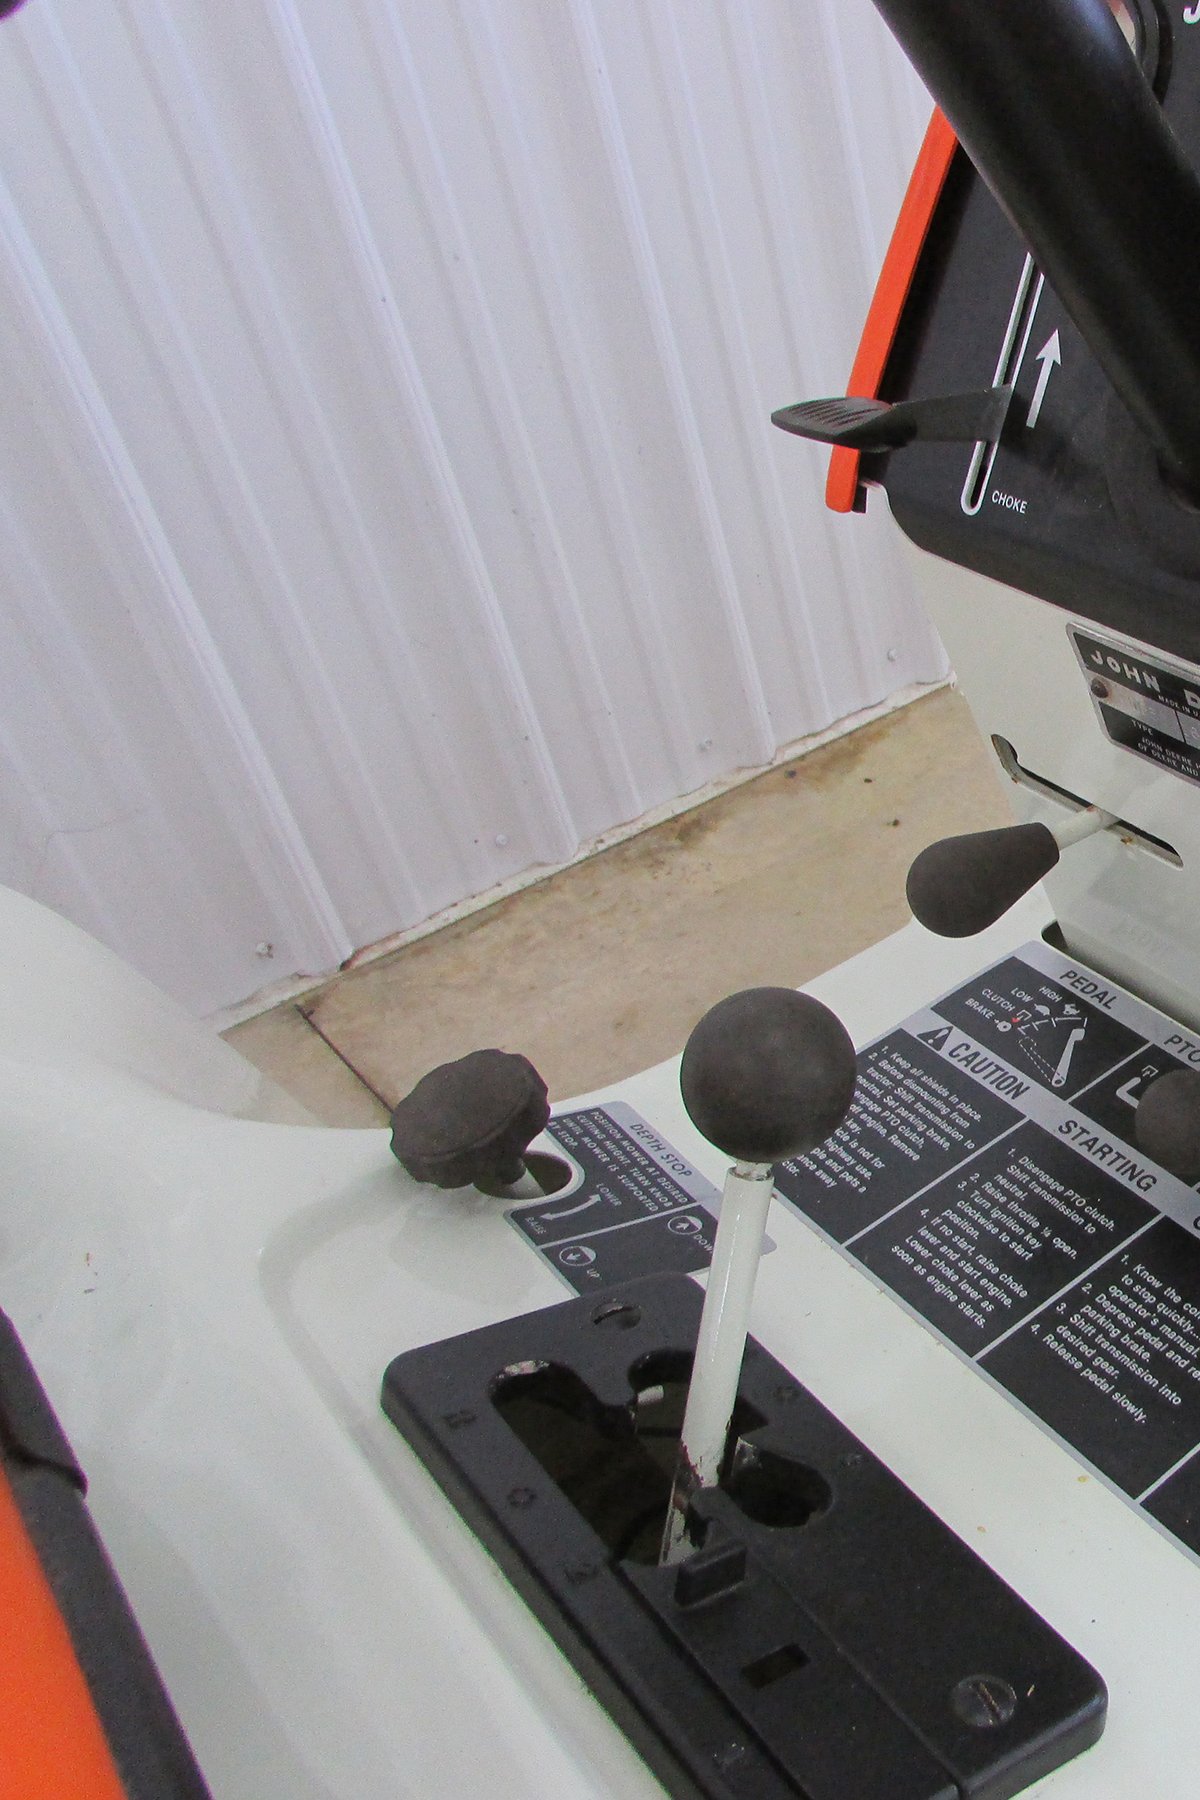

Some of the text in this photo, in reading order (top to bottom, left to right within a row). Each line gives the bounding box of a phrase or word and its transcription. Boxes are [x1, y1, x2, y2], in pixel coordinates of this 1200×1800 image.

[991, 490, 1028, 515] CHOKE
[1090, 650, 1160, 692] JOHN
[965, 998, 995, 1020] BRAKE
[981, 988, 1015, 1012] CLUTCH
[1011, 987, 1034, 1003] LOW
[1038, 985, 1063, 1003] HIGH
[1060, 970, 1118, 1010] PEDAL
[877, 1059, 904, 1079] Before
[902, 1078, 950, 1115] dismounting
[949, 1111, 970, 1128] from
[889, 1051, 911, 1069] Keep
[909, 1067, 924, 1076] all
[920, 1075, 949, 1097] shields
[948, 1094, 959, 1104] in
[948, 1043, 1031, 1100] CAUTION
[629, 1124, 693, 1178] DEPTH STOP
[1058, 1119, 1158, 1193] STARTING
[1006, 1164, 1095, 1233] Shift transmission to
[1017, 1155, 1064, 1192] Disengage
[1063, 1189, 1086, 1206] PTO
[904, 1235, 994, 1311] Lower choke lever as
[1132, 1263, 1162, 1288] Know
[1163, 1286, 1181, 1303] the
[1056, 1325, 1119, 1379] desired gear.
[1079, 1304, 1150, 1362] parking brake.
[1094, 1292, 1136, 1328] Depress
[1133, 1326, 1168, 1351] pedal
[1165, 1350, 1190, 1368] and
[1042, 1333, 1082, 1369] Release
[1079, 1368, 1114, 1393] pedal
[1111, 1392, 1146, 1423] slowly.
[1069, 1313, 1096, 1336] Shift
[1094, 1333, 1158, 1387] transmission
[1158, 1383, 1181, 1405] into
